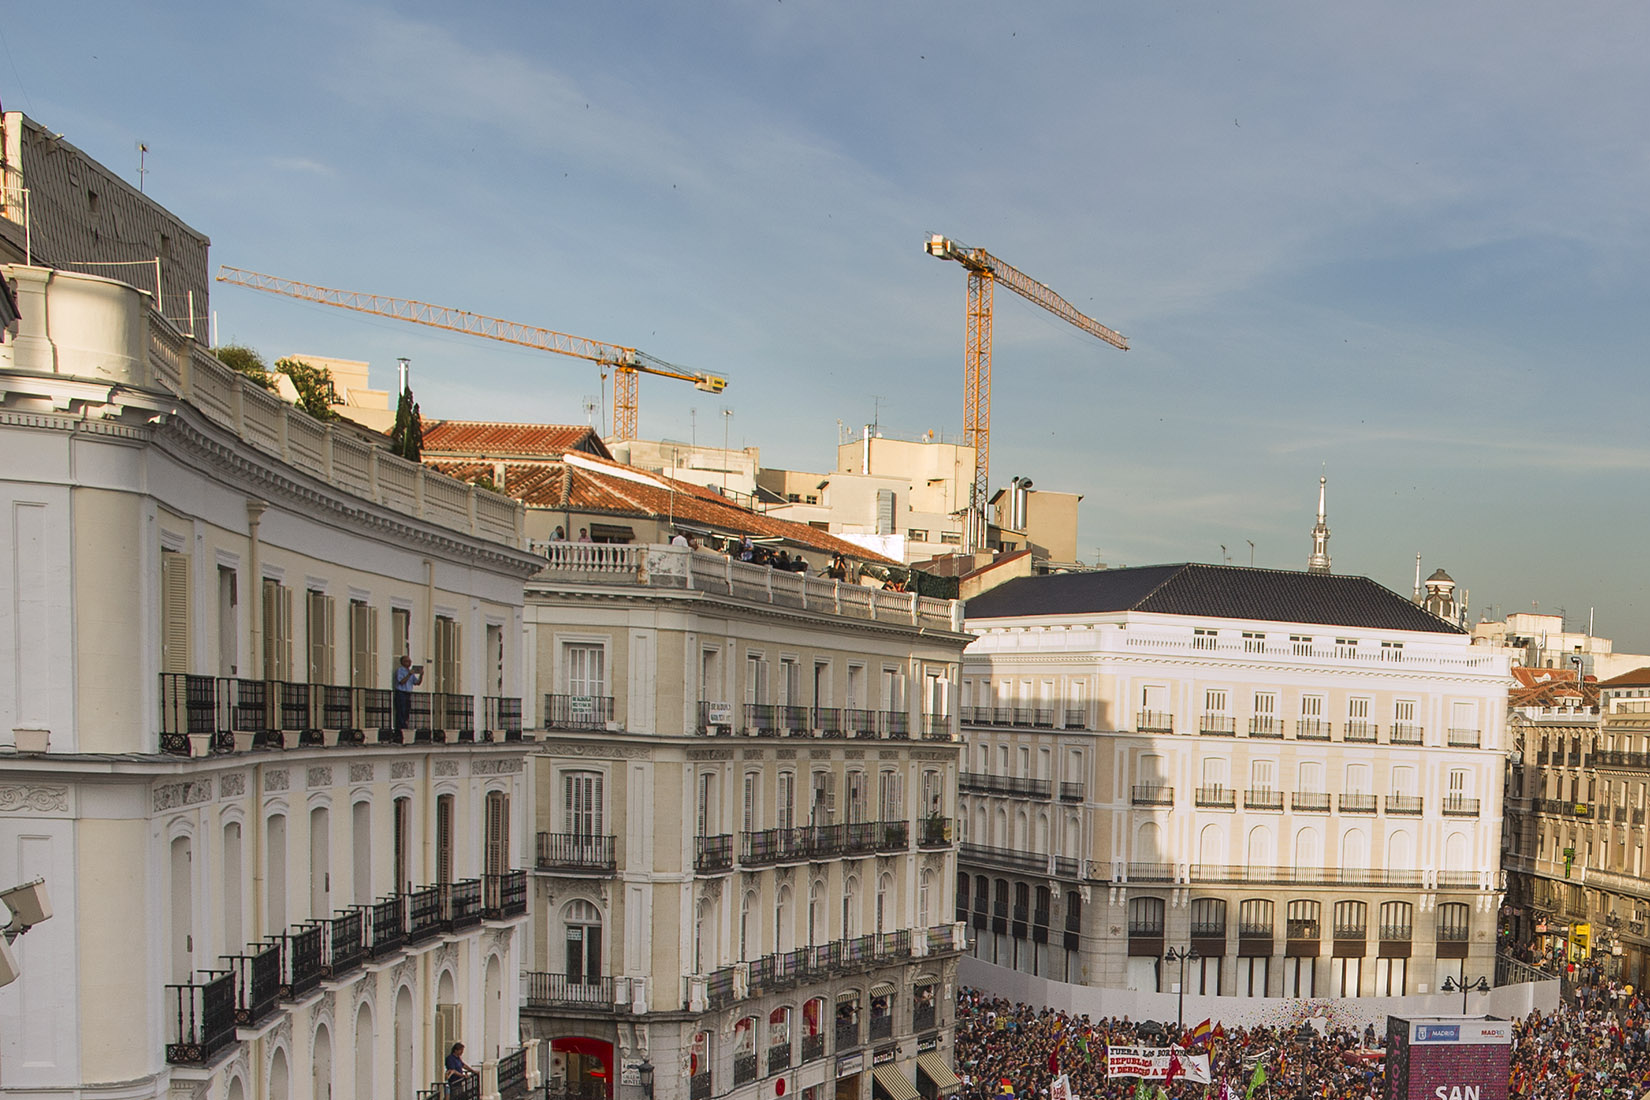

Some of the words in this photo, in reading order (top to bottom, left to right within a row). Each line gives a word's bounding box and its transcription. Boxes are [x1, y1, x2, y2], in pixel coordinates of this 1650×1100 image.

[1110, 1048, 1138, 1056] FUERA
[1110, 1057, 1152, 1067] REPUBLICA
[1118, 1067, 1150, 1076] DERECHO
